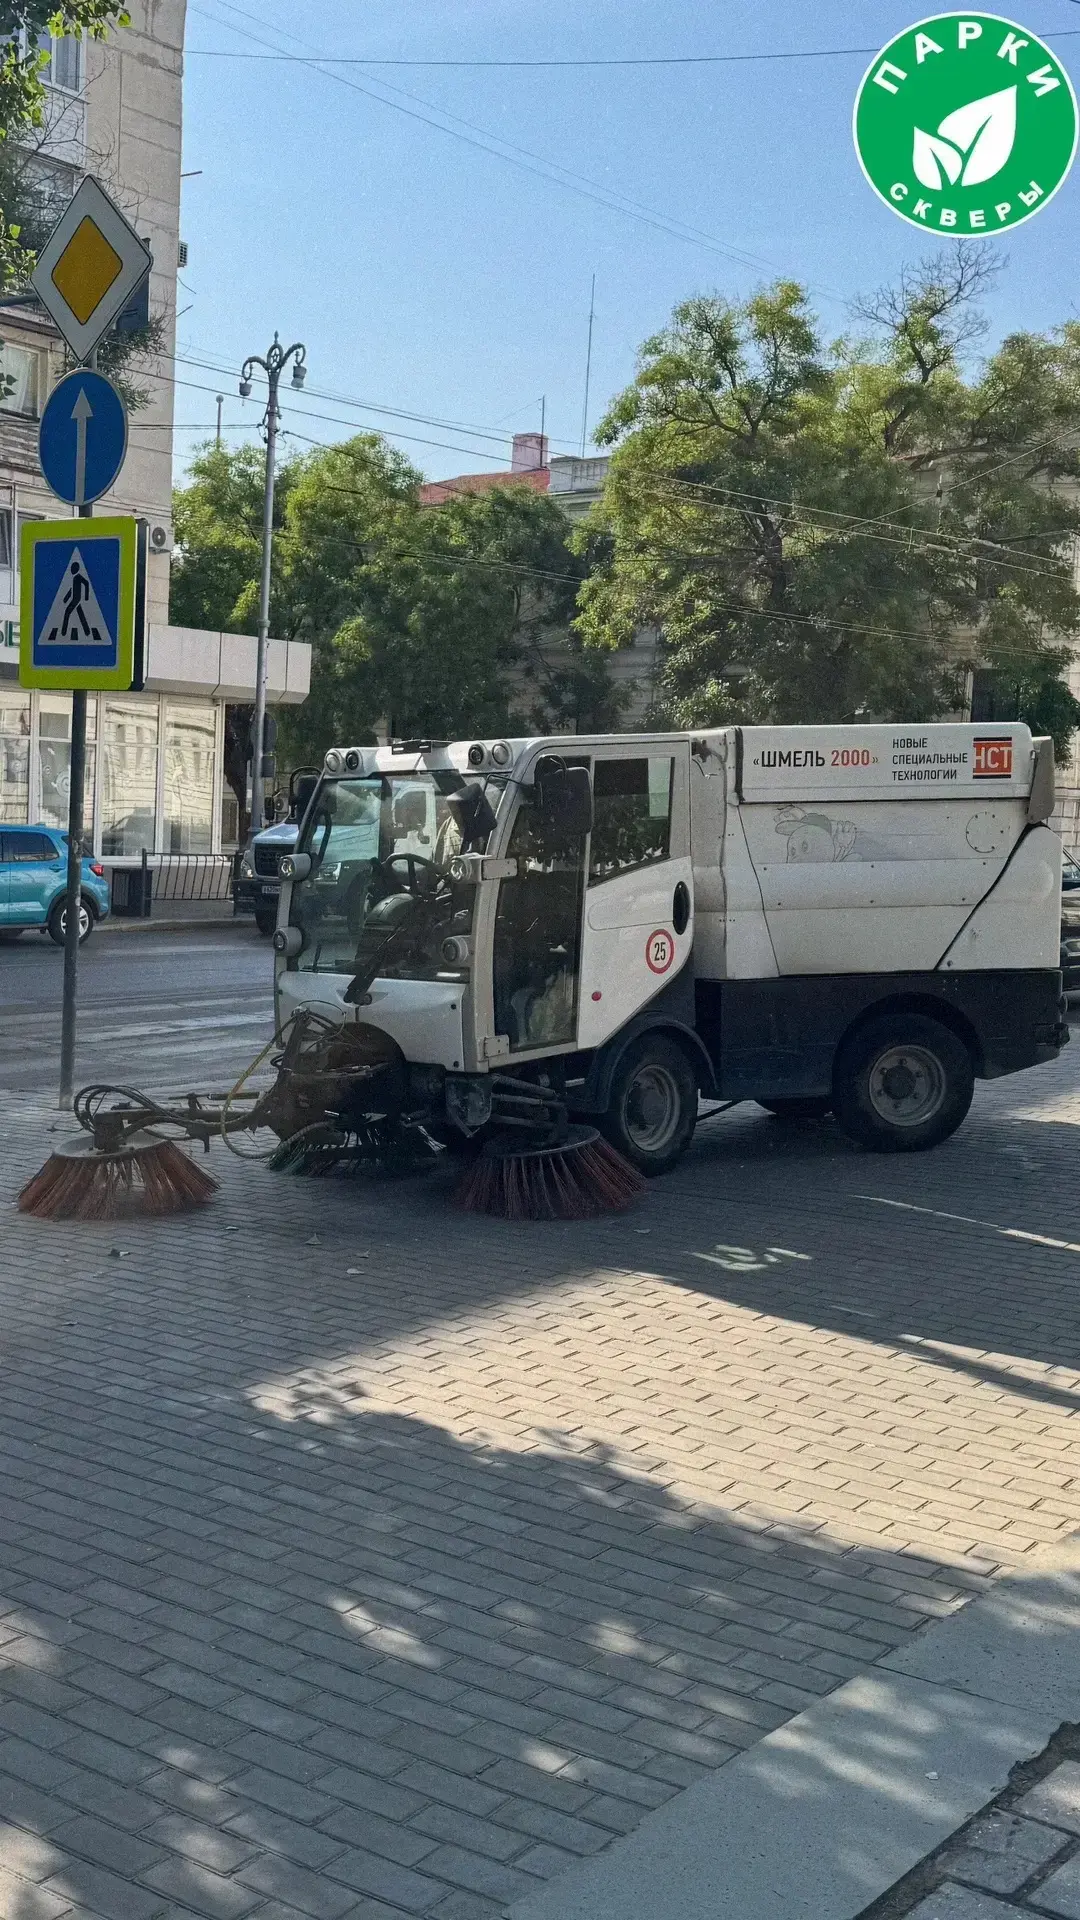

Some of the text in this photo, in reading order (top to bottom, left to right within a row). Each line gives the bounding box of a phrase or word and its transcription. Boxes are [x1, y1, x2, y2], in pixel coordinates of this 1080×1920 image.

[892, 738, 928, 748] НОВЫЕ
[753, 749, 878, 768] «ШМЕЛЬ 2000»
[892, 753, 968, 765] СПЕЦИАЛЬНЫЕ
[973, 746, 1012, 769] НСТ
[892, 769, 957, 781] ТЕХНОЛОГИИ
[654, 942, 666, 961] 25
